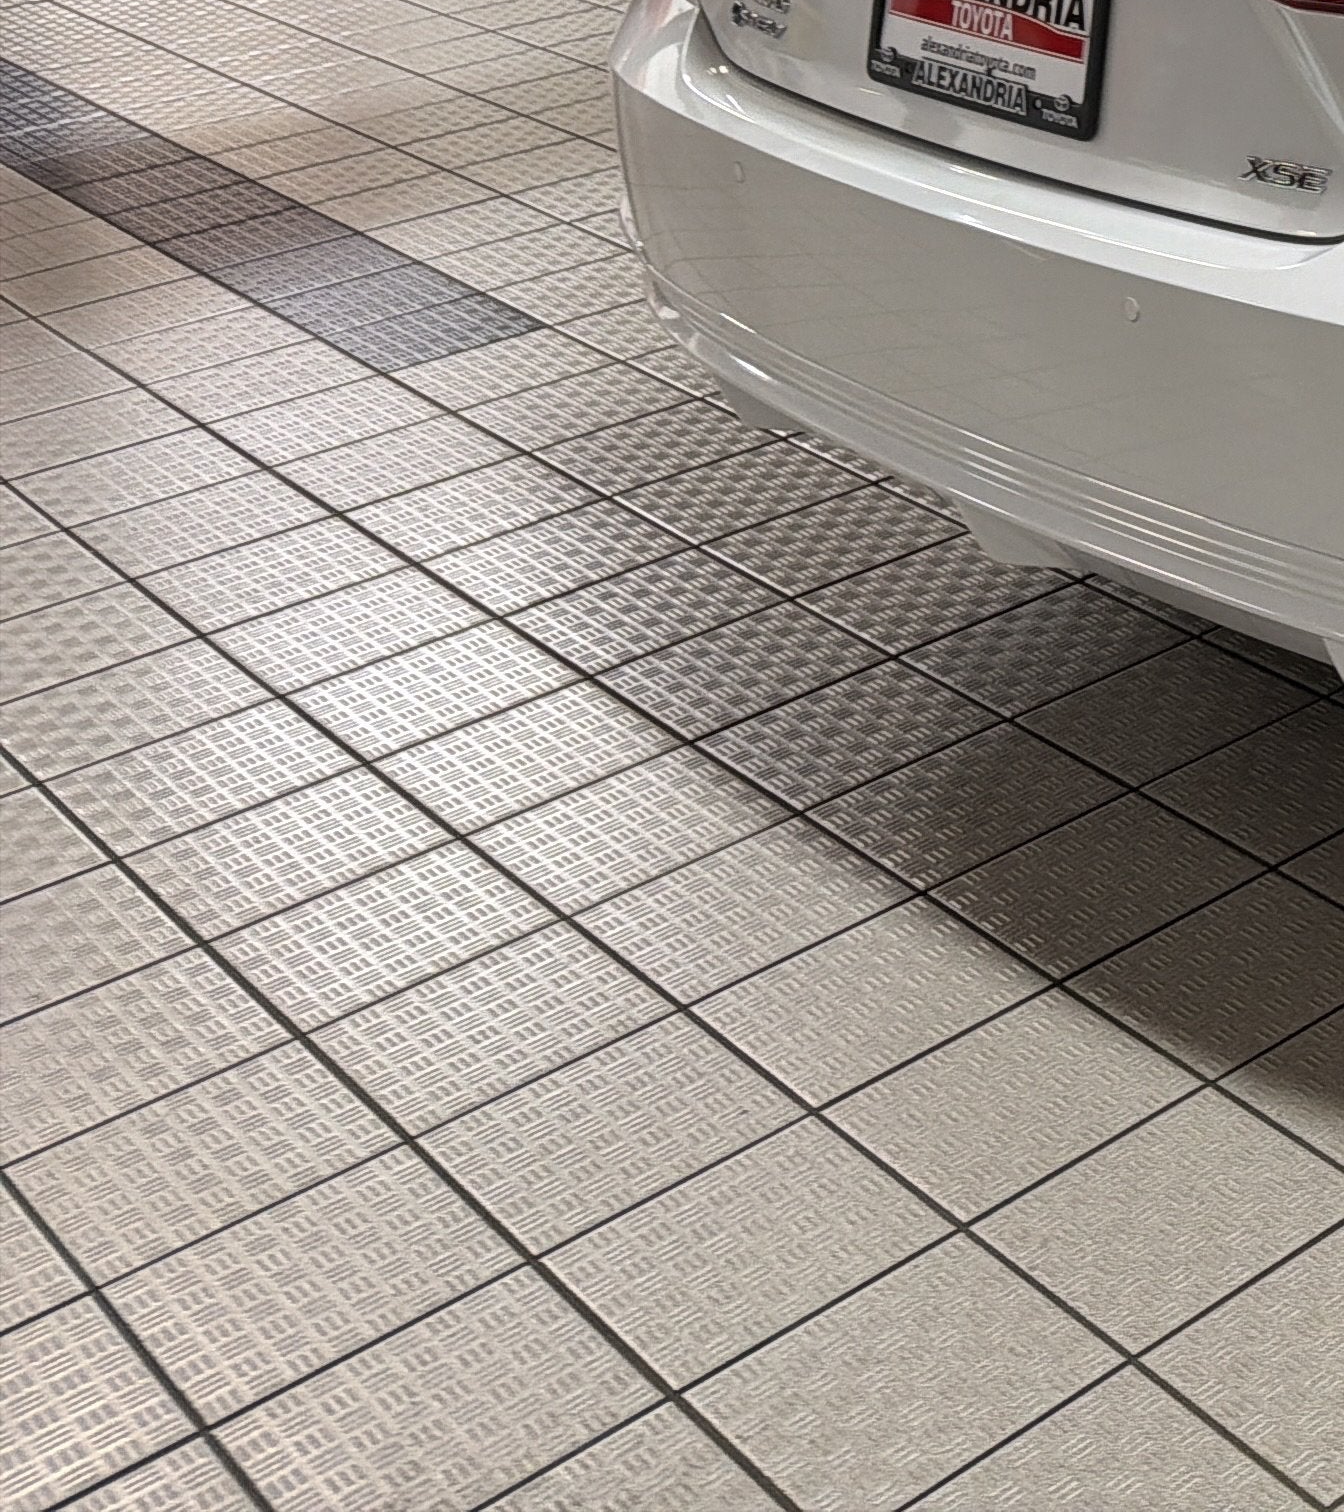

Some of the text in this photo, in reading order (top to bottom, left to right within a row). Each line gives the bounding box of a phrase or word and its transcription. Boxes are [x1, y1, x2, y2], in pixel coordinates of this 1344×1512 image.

[951, 0, 1014, 42] TOYOTA
[920, 35, 1037, 82] alexandriatoyota.com
[911, 59, 1028, 117] ALEXANDRIA
[1237, 155, 1334, 195] XSE
